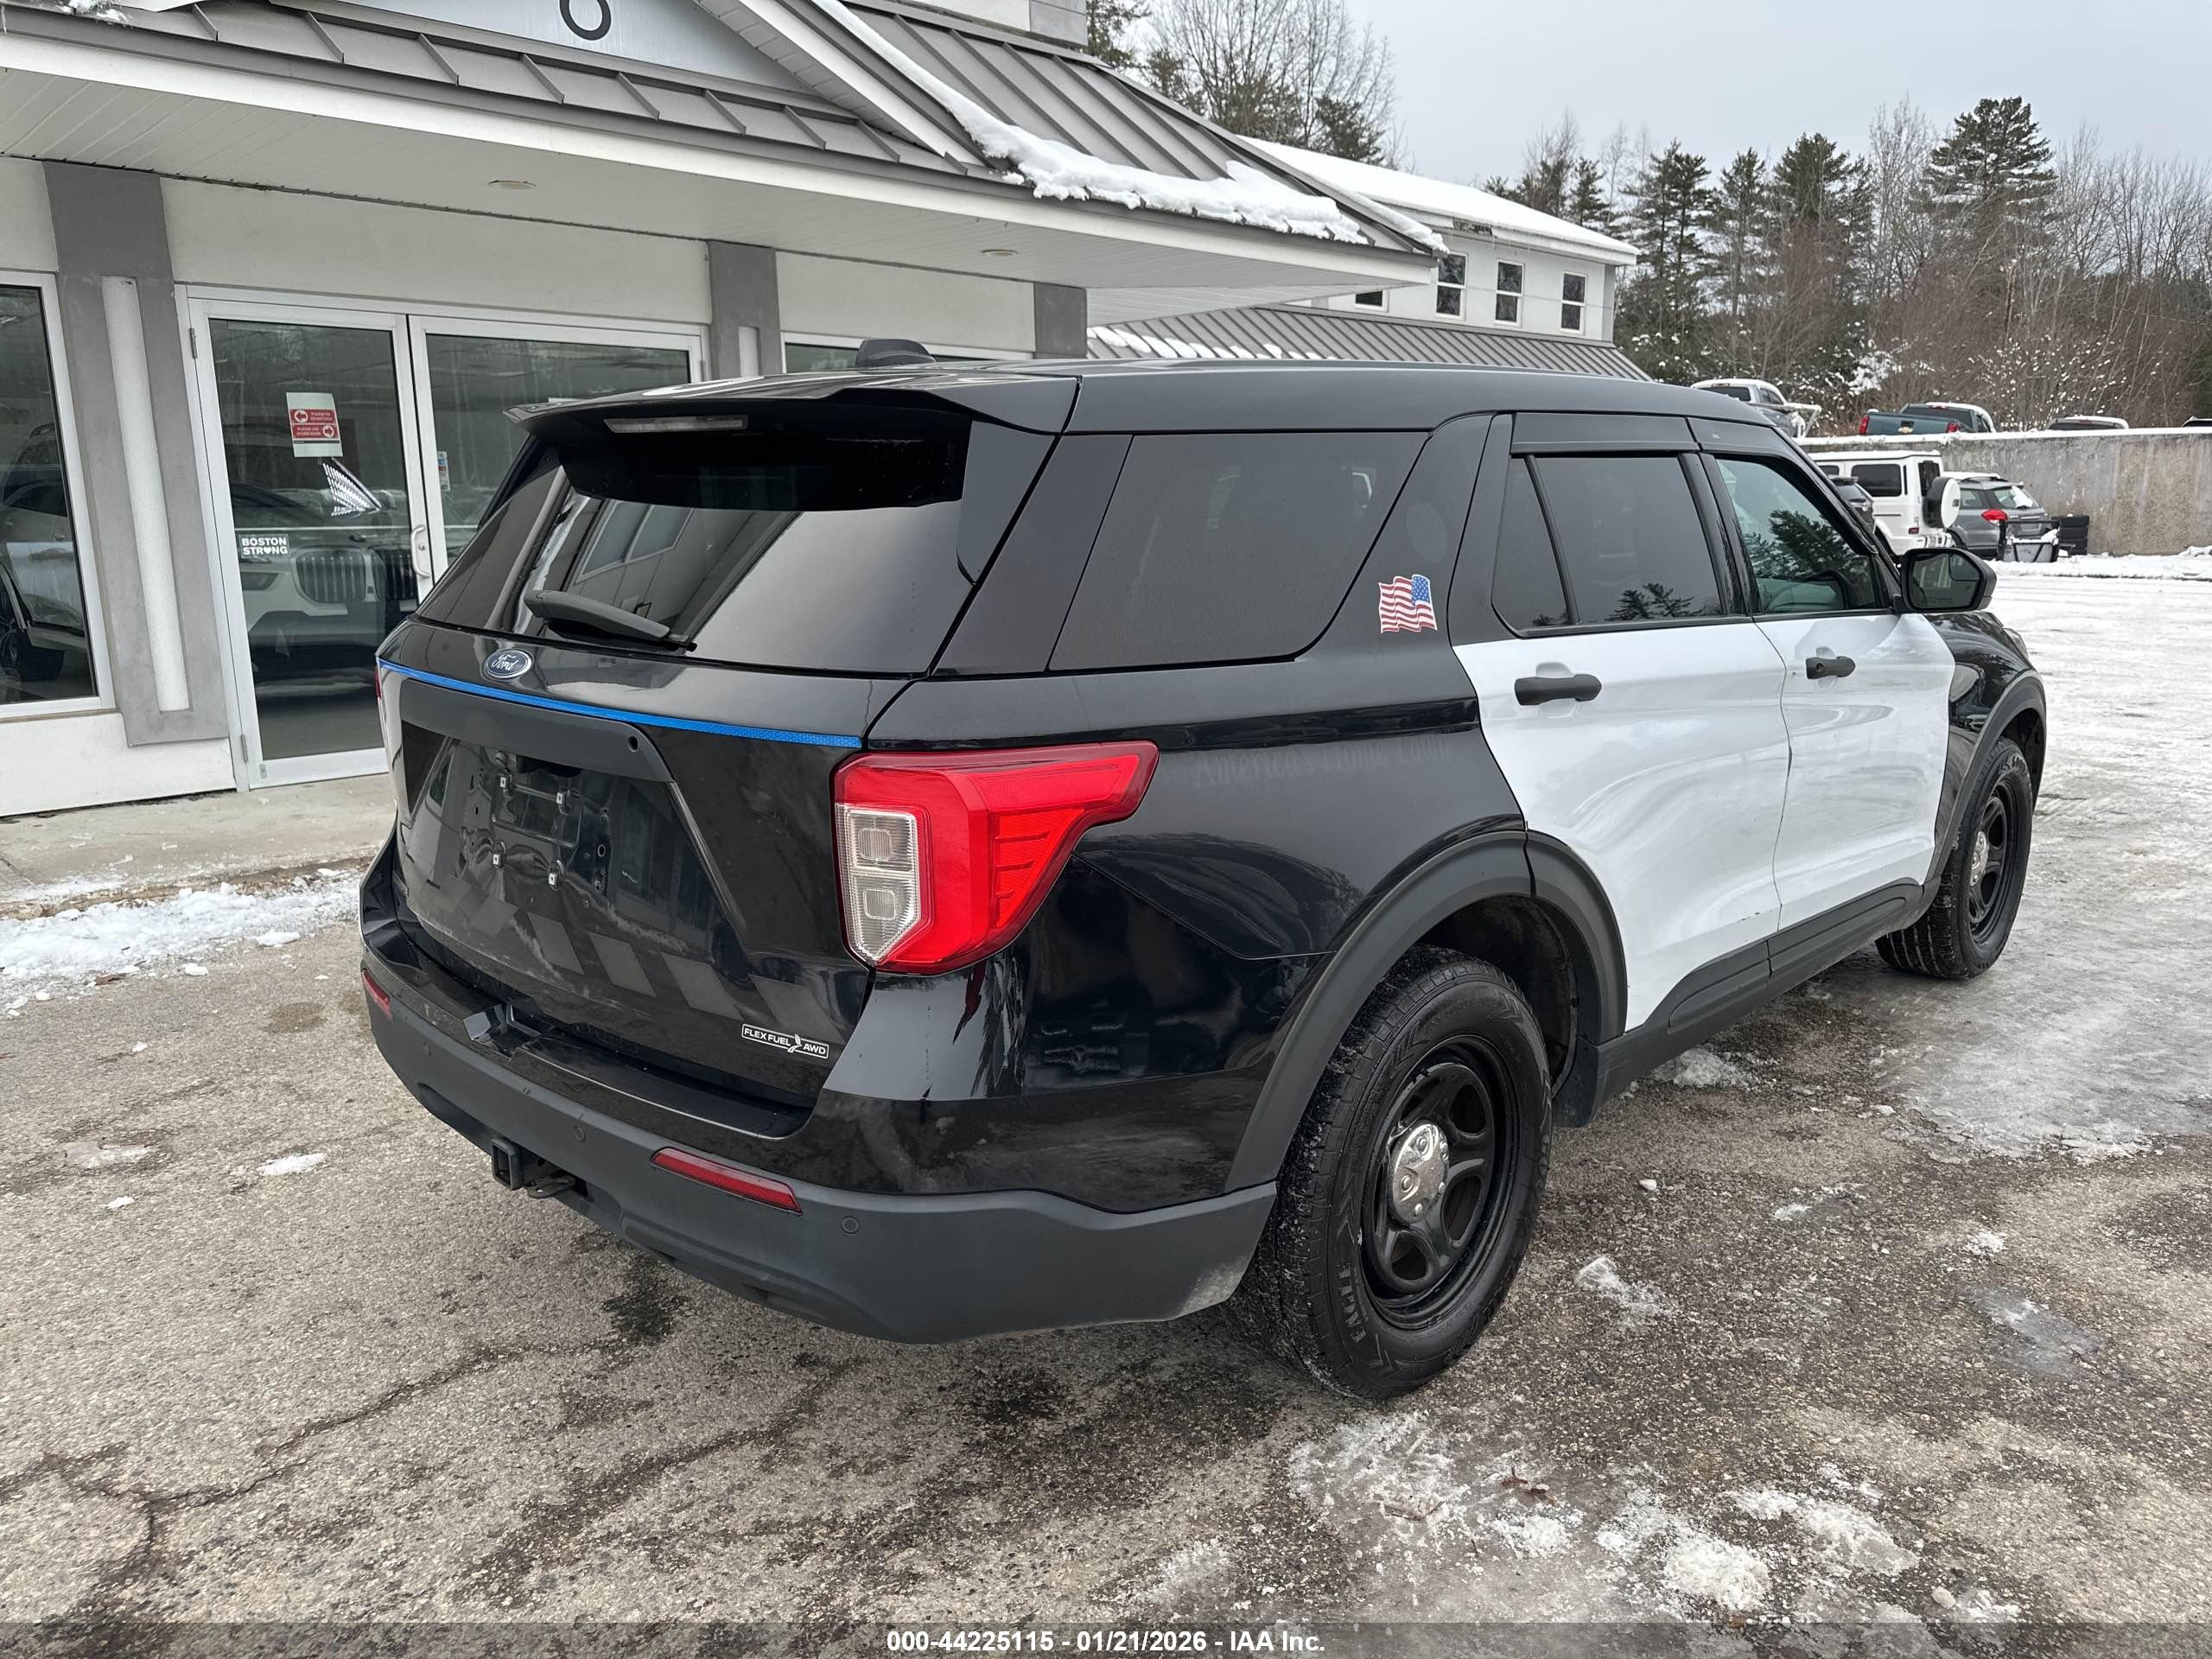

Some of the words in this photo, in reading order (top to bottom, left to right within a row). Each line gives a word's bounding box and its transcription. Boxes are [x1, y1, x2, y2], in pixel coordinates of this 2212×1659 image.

[242, 537, 287, 546] BOSTON
[491, 653, 519, 671] Ford
[744, 1027, 766, 1040] FLEX
[767, 1033, 791, 1046] FUEL
[803, 1043, 826, 1055] AWD
